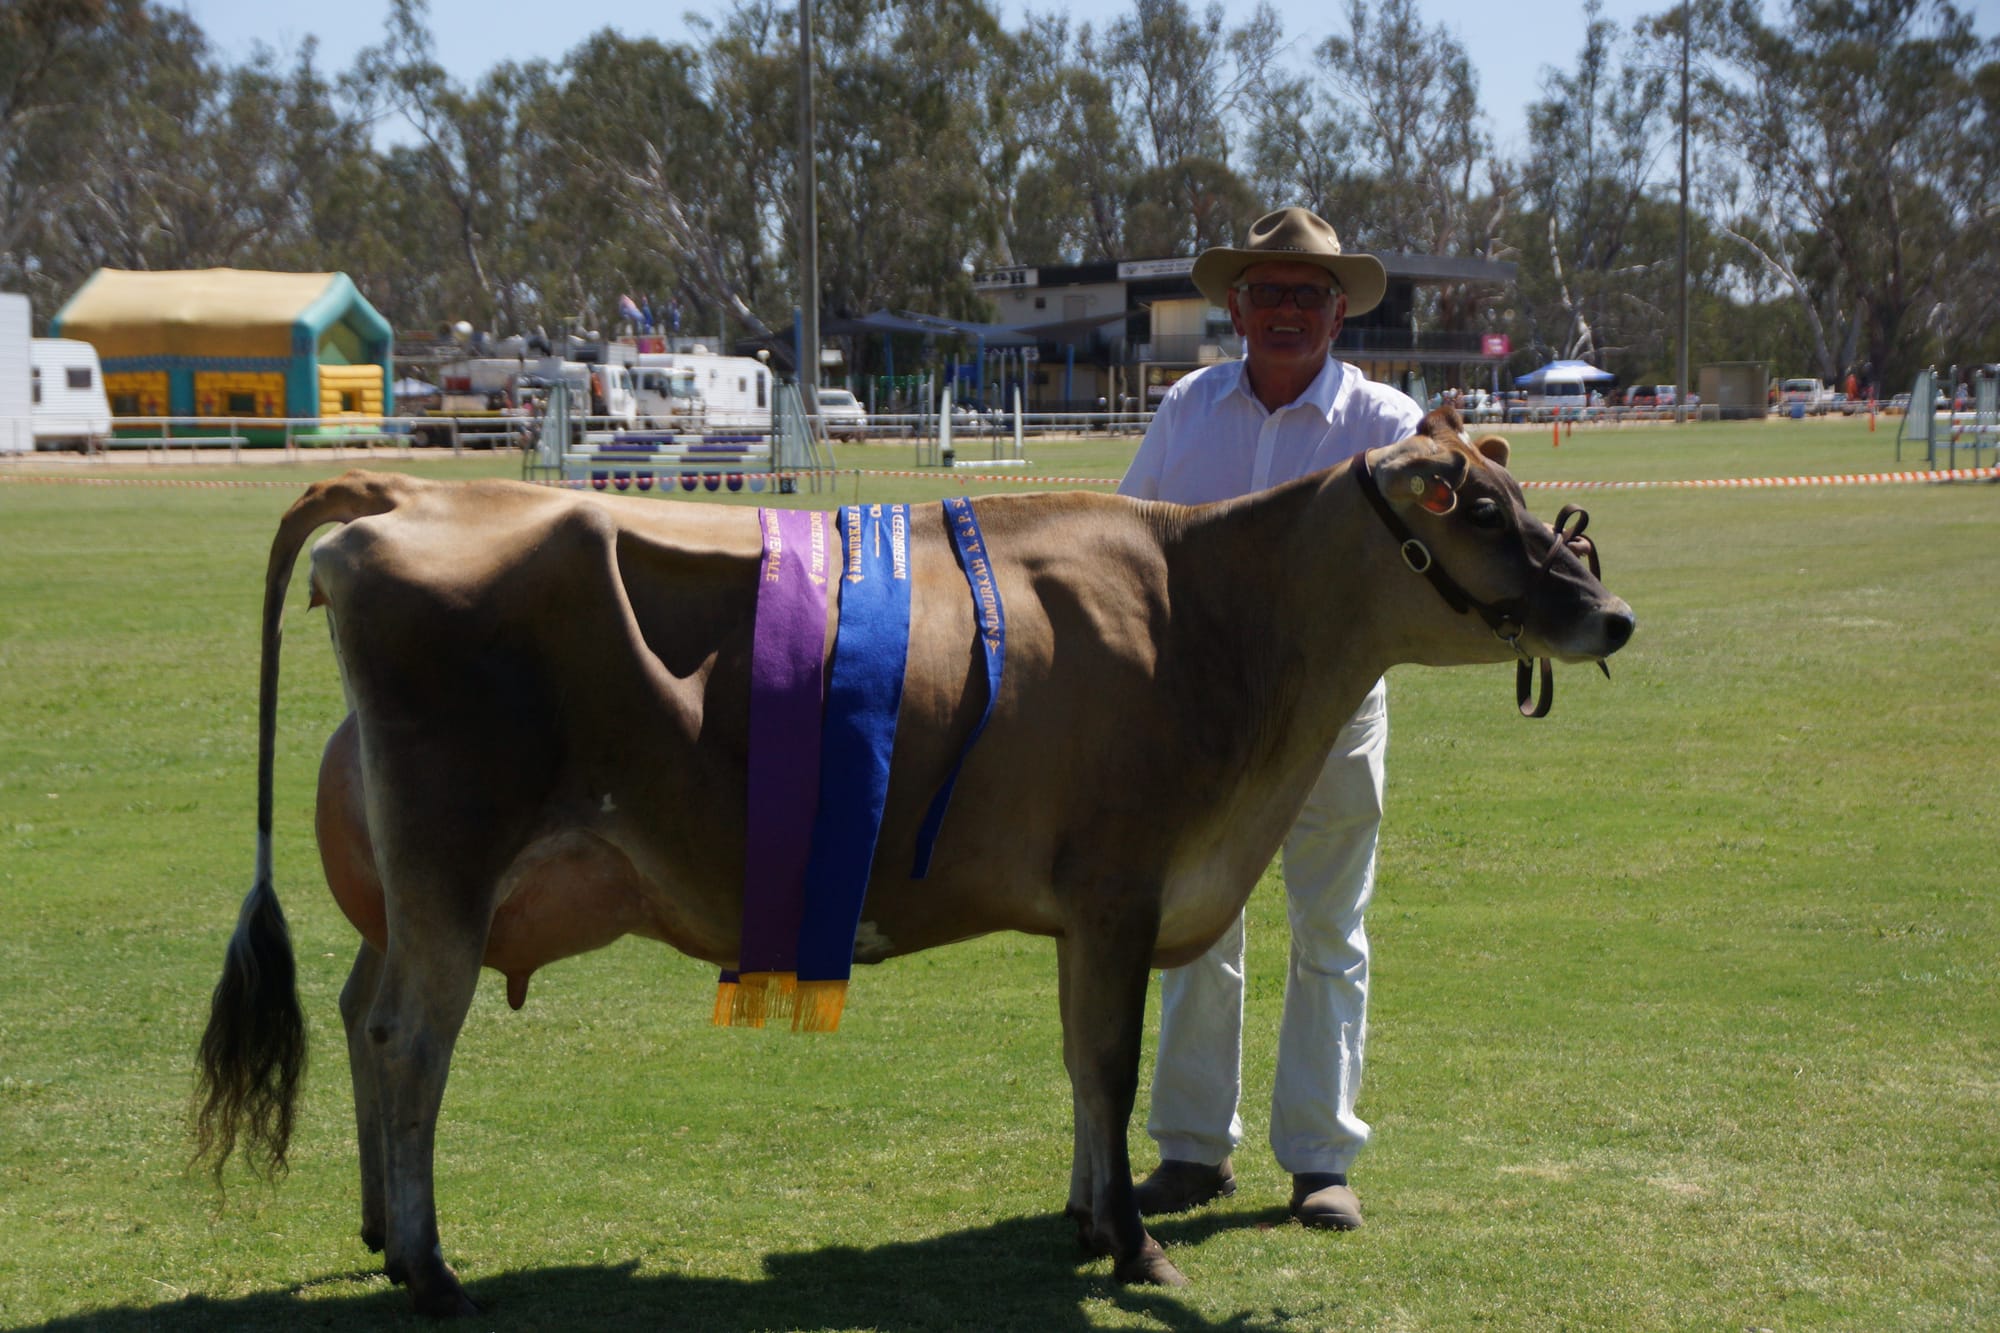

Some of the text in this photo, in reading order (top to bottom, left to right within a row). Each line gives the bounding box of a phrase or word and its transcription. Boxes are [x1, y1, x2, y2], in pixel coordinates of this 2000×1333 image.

[810, 511, 824, 551] SOCIETY
[847, 512, 862, 573] NUMURKAH
[892, 514, 906, 579] INTERBREED
[962, 526, 976, 537] &
[766, 536, 782, 582] FEMALE
[972, 559, 1000, 637] NUMURKAH
